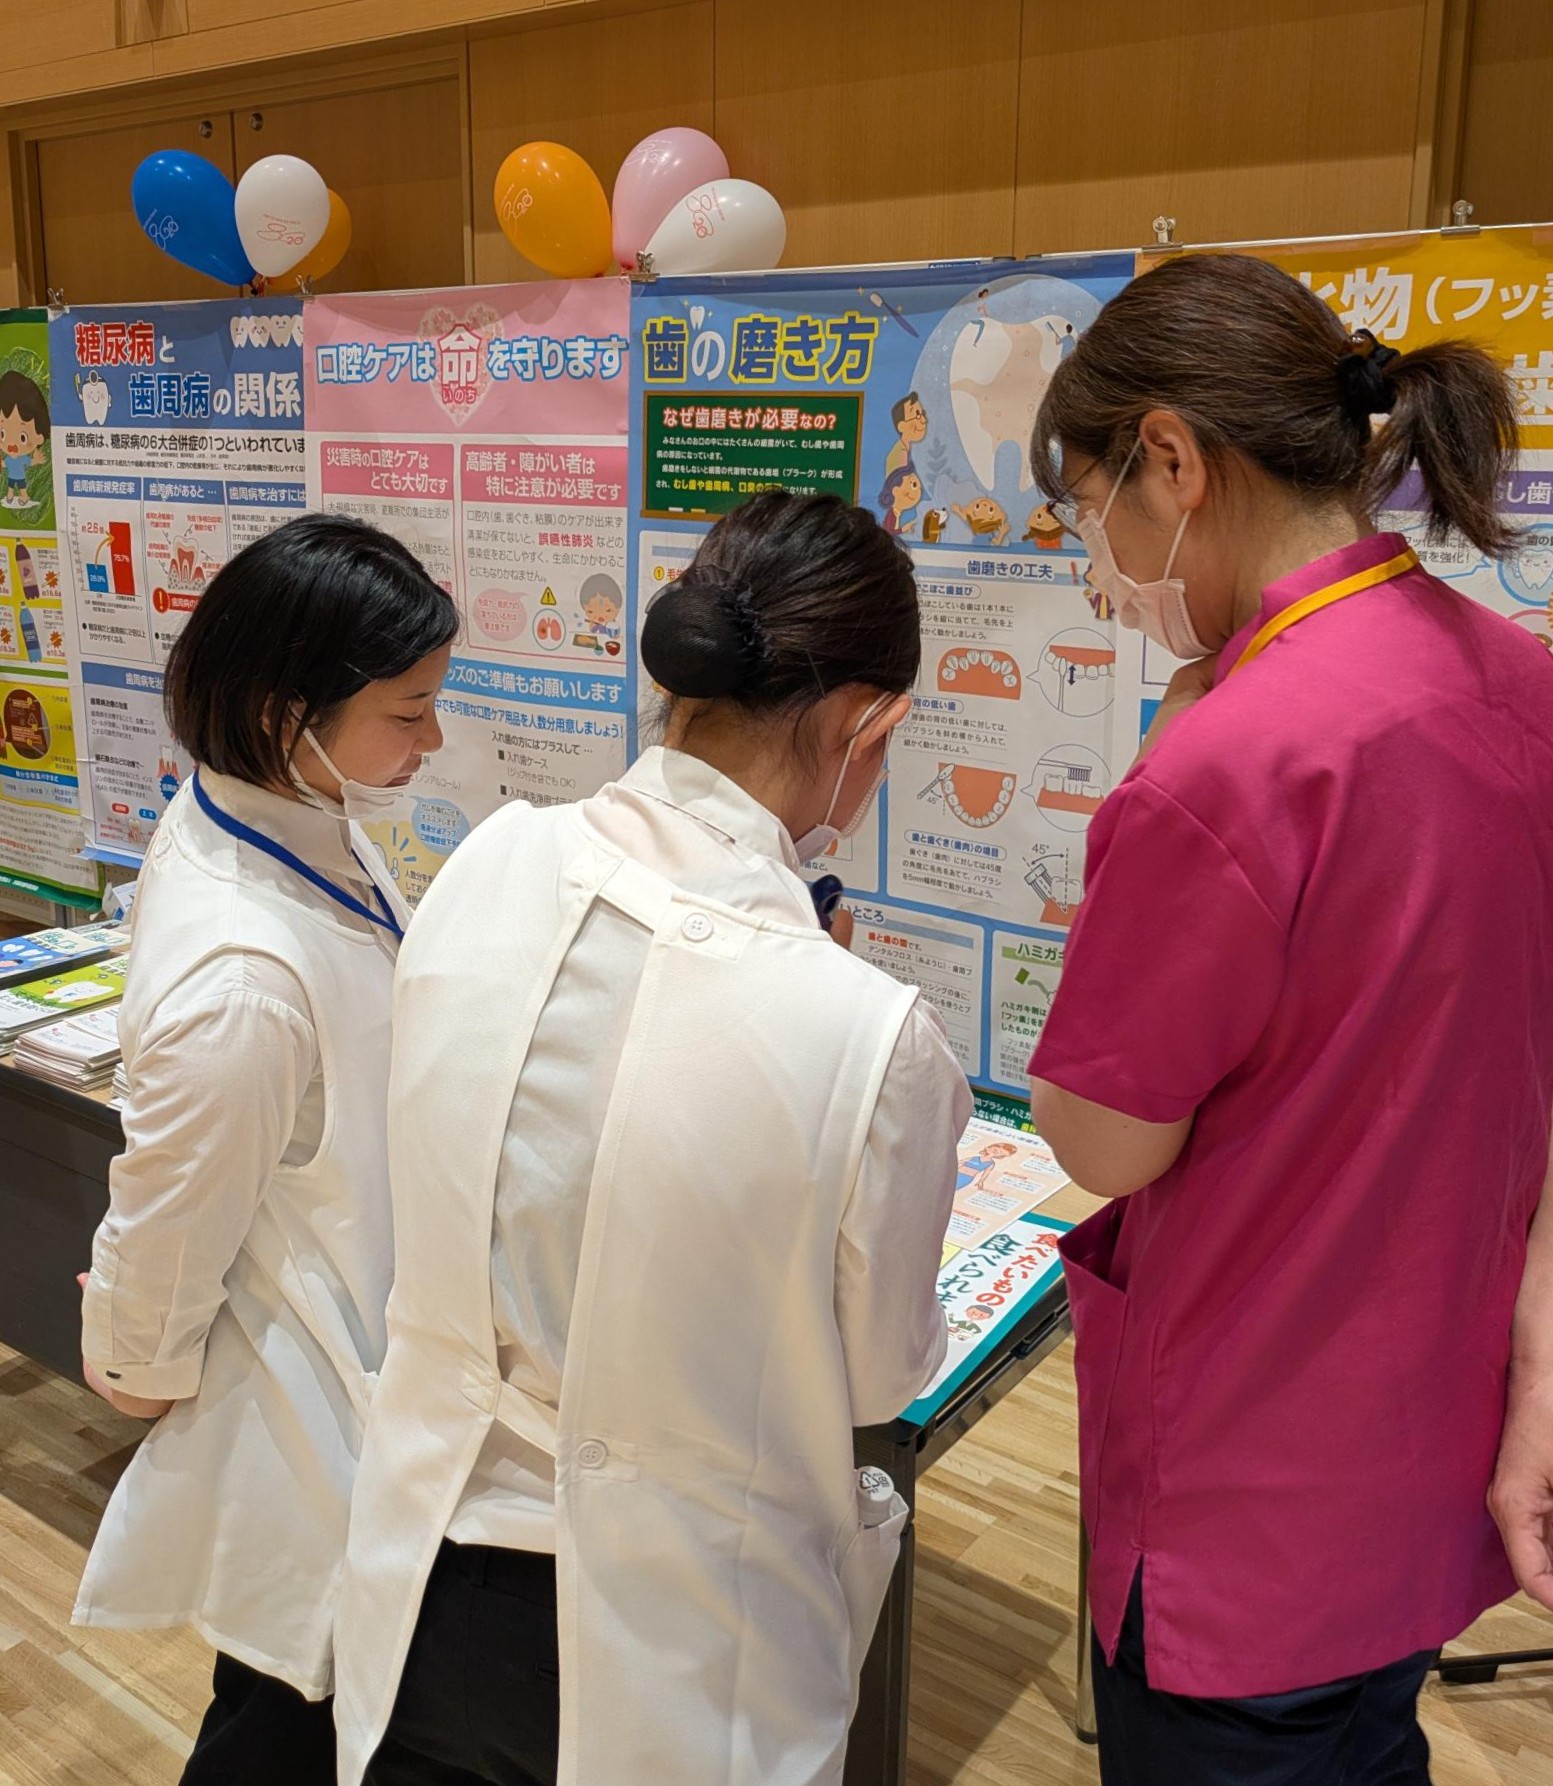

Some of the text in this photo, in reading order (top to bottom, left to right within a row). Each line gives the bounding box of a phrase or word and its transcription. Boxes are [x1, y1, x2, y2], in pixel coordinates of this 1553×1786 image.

[1290, 266, 1553, 341] 物（フッ
[74, 320, 175, 367] 糖尿病と
[643, 311, 878, 384] 歯の磨き方
[128, 371, 301, 418] 歯周病の関係
[442, 386, 477, 404] いのち
[663, 407, 836, 431] なぜ歯磨きが必要なの？
[327, 447, 429, 470] 災害時の口腔ケアは
[466, 451, 596, 474] 高齢者・障がい者は
[370, 472, 448, 495] とても大切です
[486, 478, 622, 501] 特に注意が必要です
[1497, 481, 1553, 505] し歯
[967, 560, 1053, 579] 歯磨きの工夫
[507, 751, 549, 770] 入れ歯ケース
